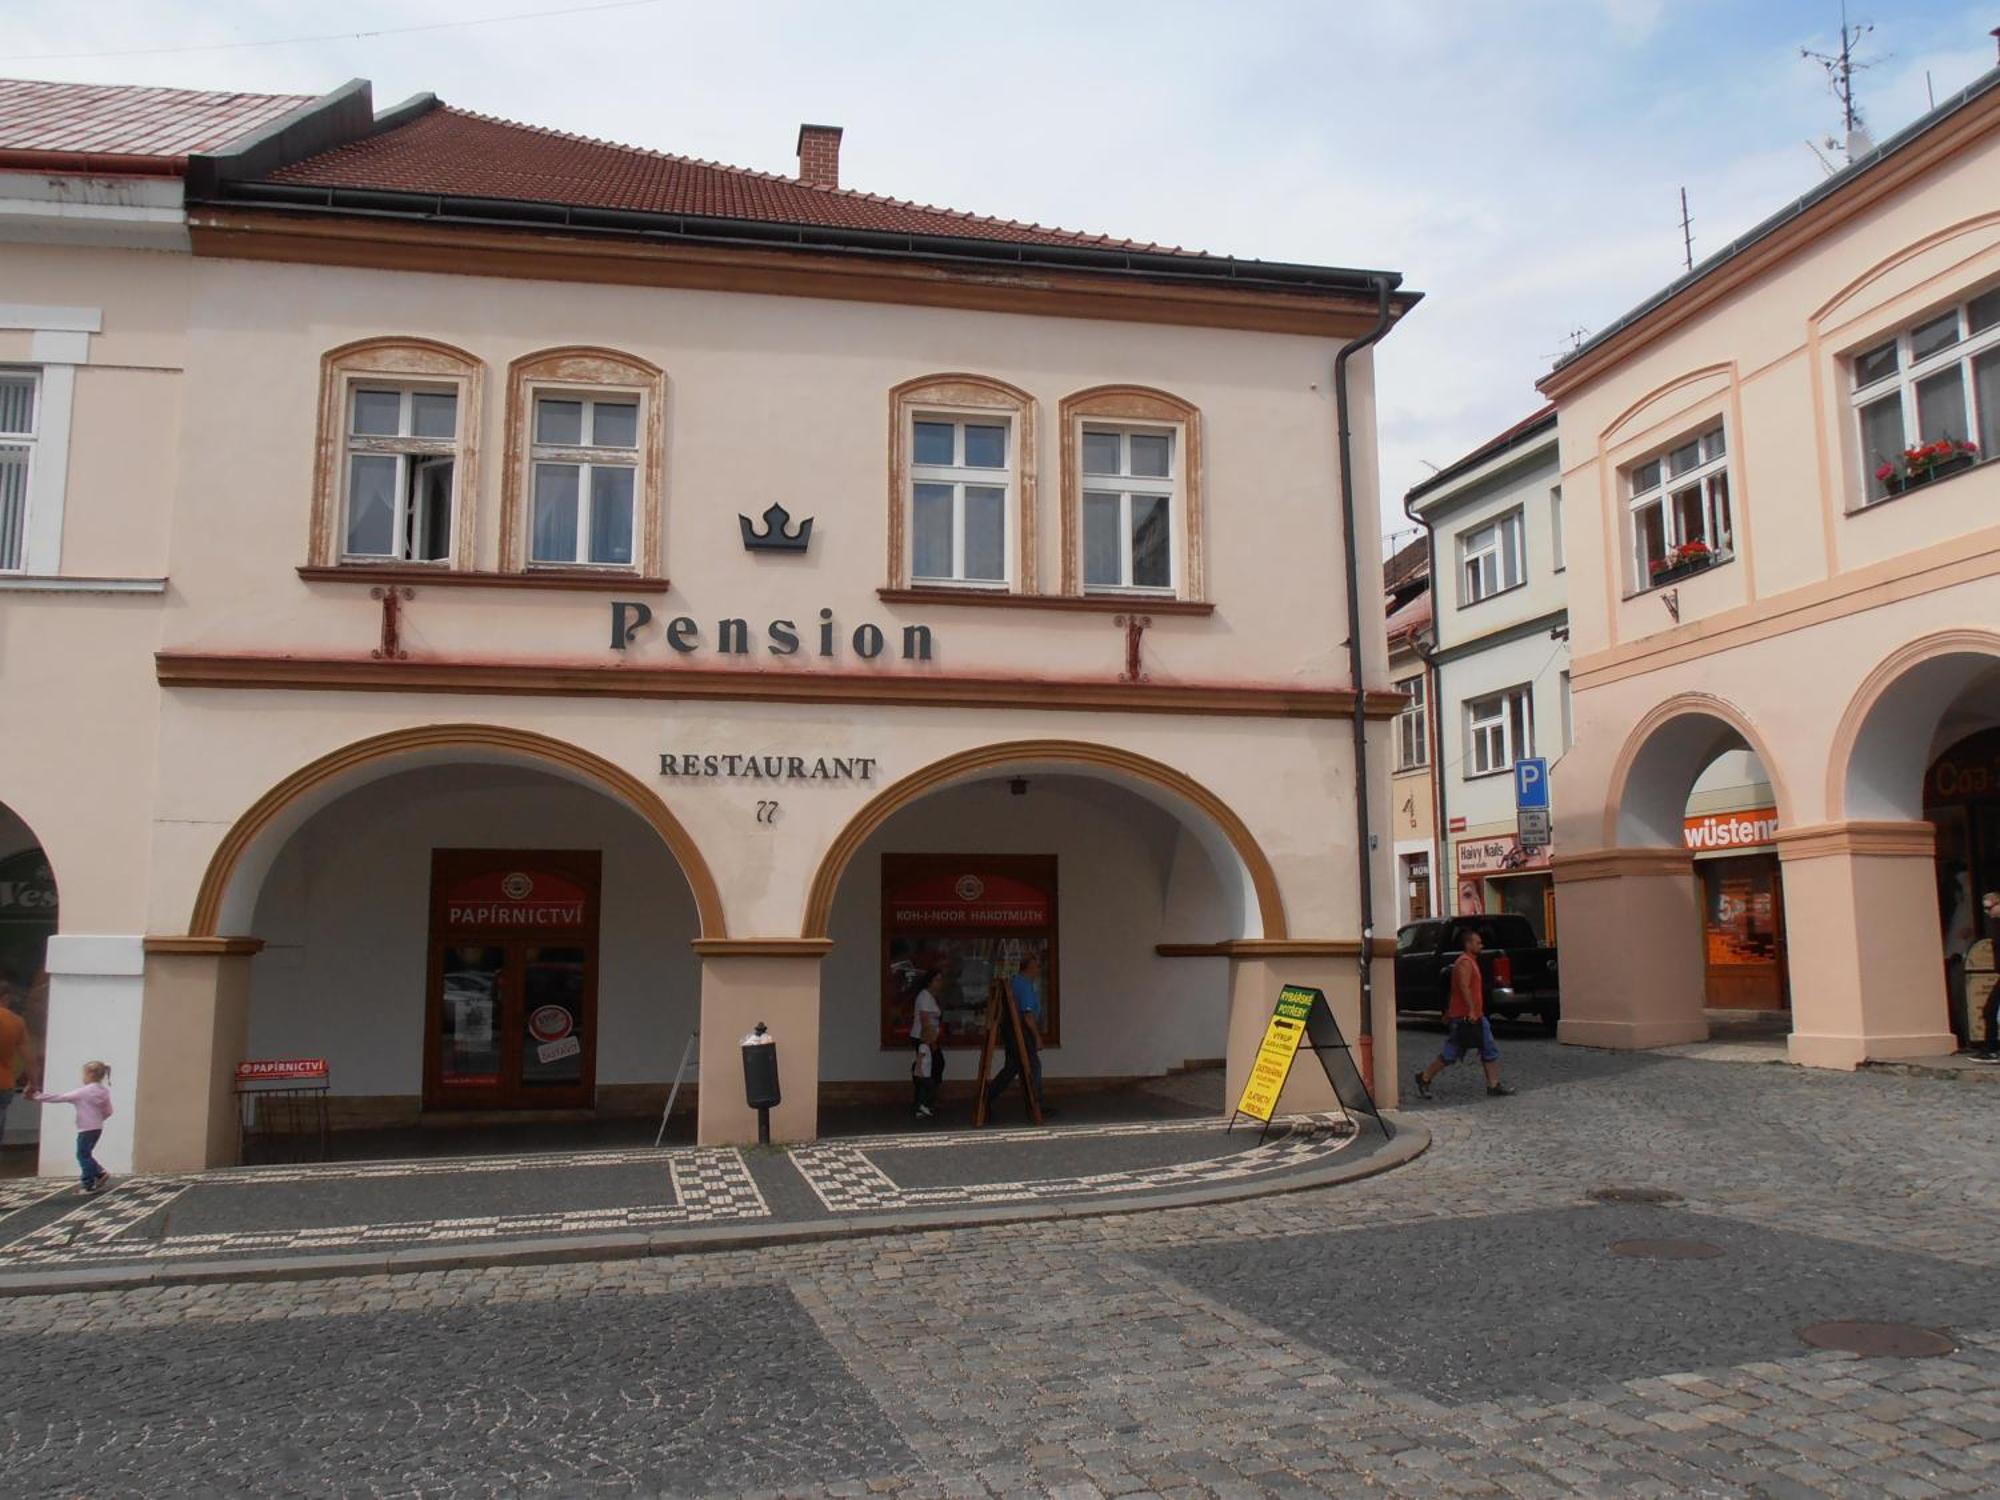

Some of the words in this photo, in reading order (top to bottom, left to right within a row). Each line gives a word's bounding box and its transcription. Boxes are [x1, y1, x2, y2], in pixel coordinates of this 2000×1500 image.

[610, 601, 932, 660] Pension
[659, 753, 876, 780] RESTAURANT
[1521, 764, 1540, 794] P
[756, 801, 779, 823] 77
[1484, 843, 1504, 858] Nails
[449, 903, 584, 924] PAPÍRNICTVÍ
[896, 910, 966, 921] KOH-I-NOOR
[971, 910, 1043, 921] HARDTMUTH
[253, 1060, 323, 1073] PAPÍRNICTVÍ
